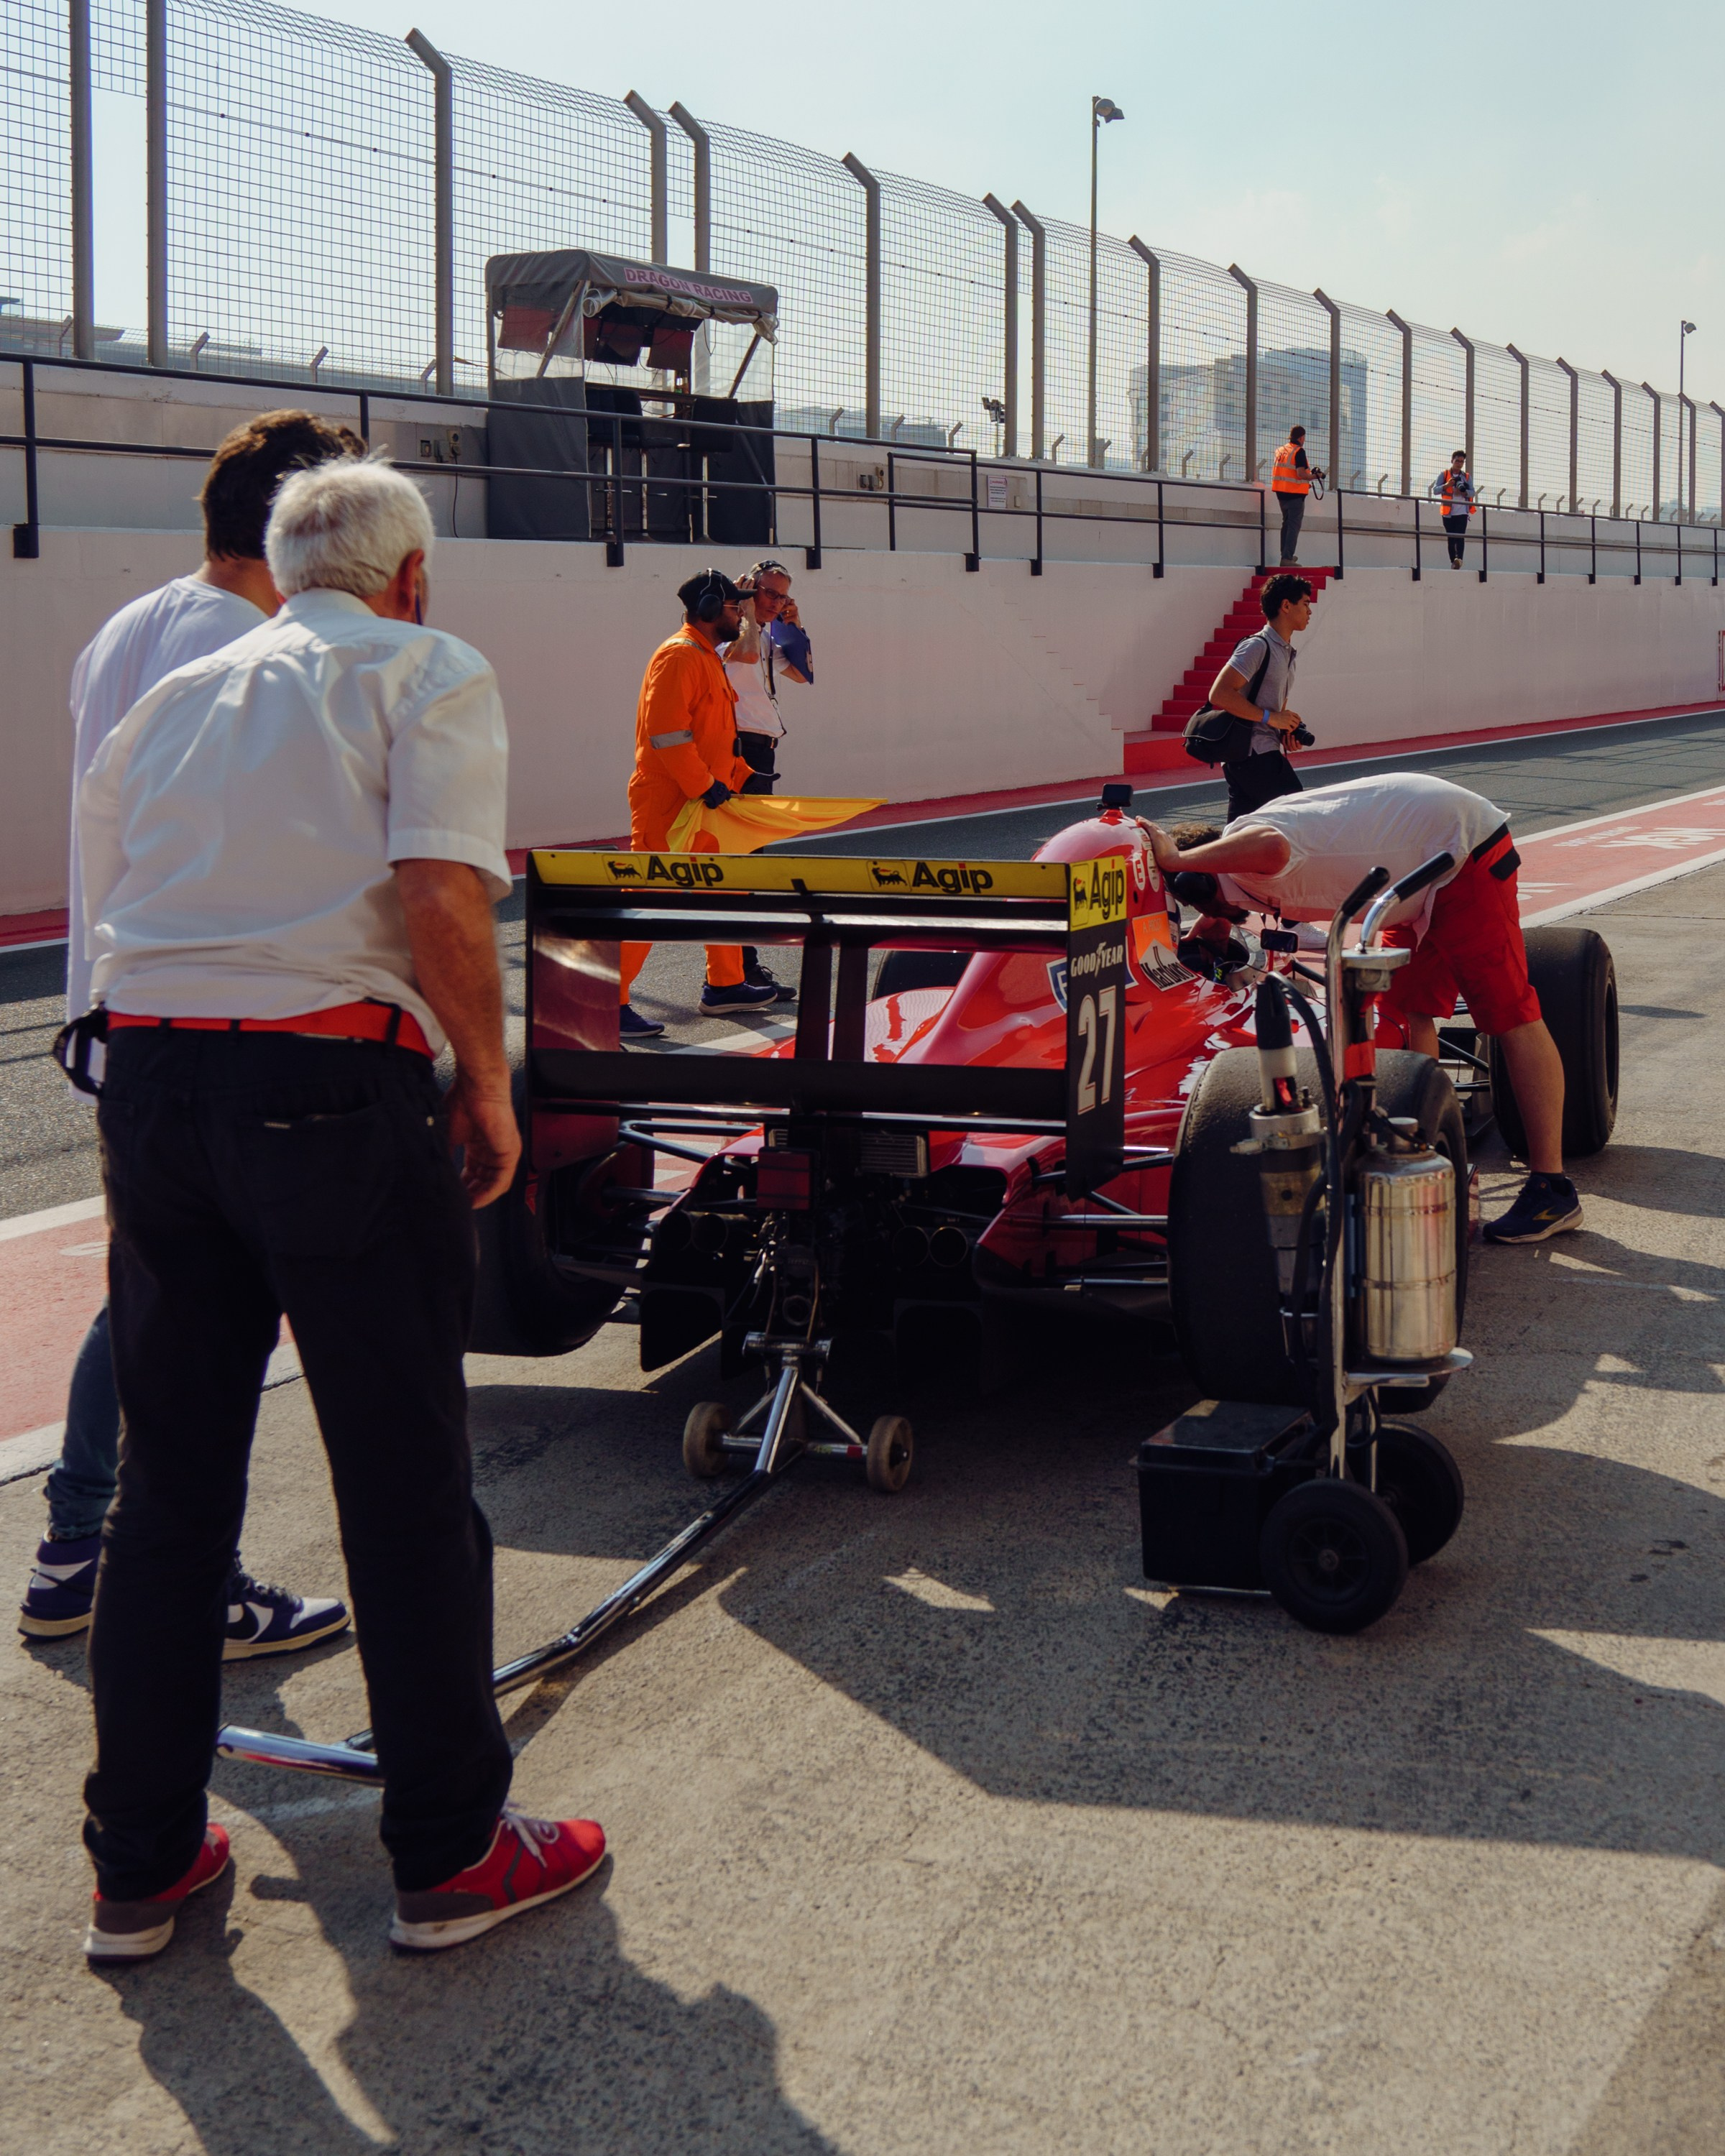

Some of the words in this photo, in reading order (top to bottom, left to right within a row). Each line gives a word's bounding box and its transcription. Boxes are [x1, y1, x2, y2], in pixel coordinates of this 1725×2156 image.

[625, 268, 691, 291] DRAGON
[693, 283, 753, 303] RACING
[647, 855, 724, 887] Agip
[911, 862, 993, 894] Agip
[1089, 859, 1125, 920] Agip
[1140, 946, 1195, 989] Marlboro
[1077, 985, 1117, 1115] 27
